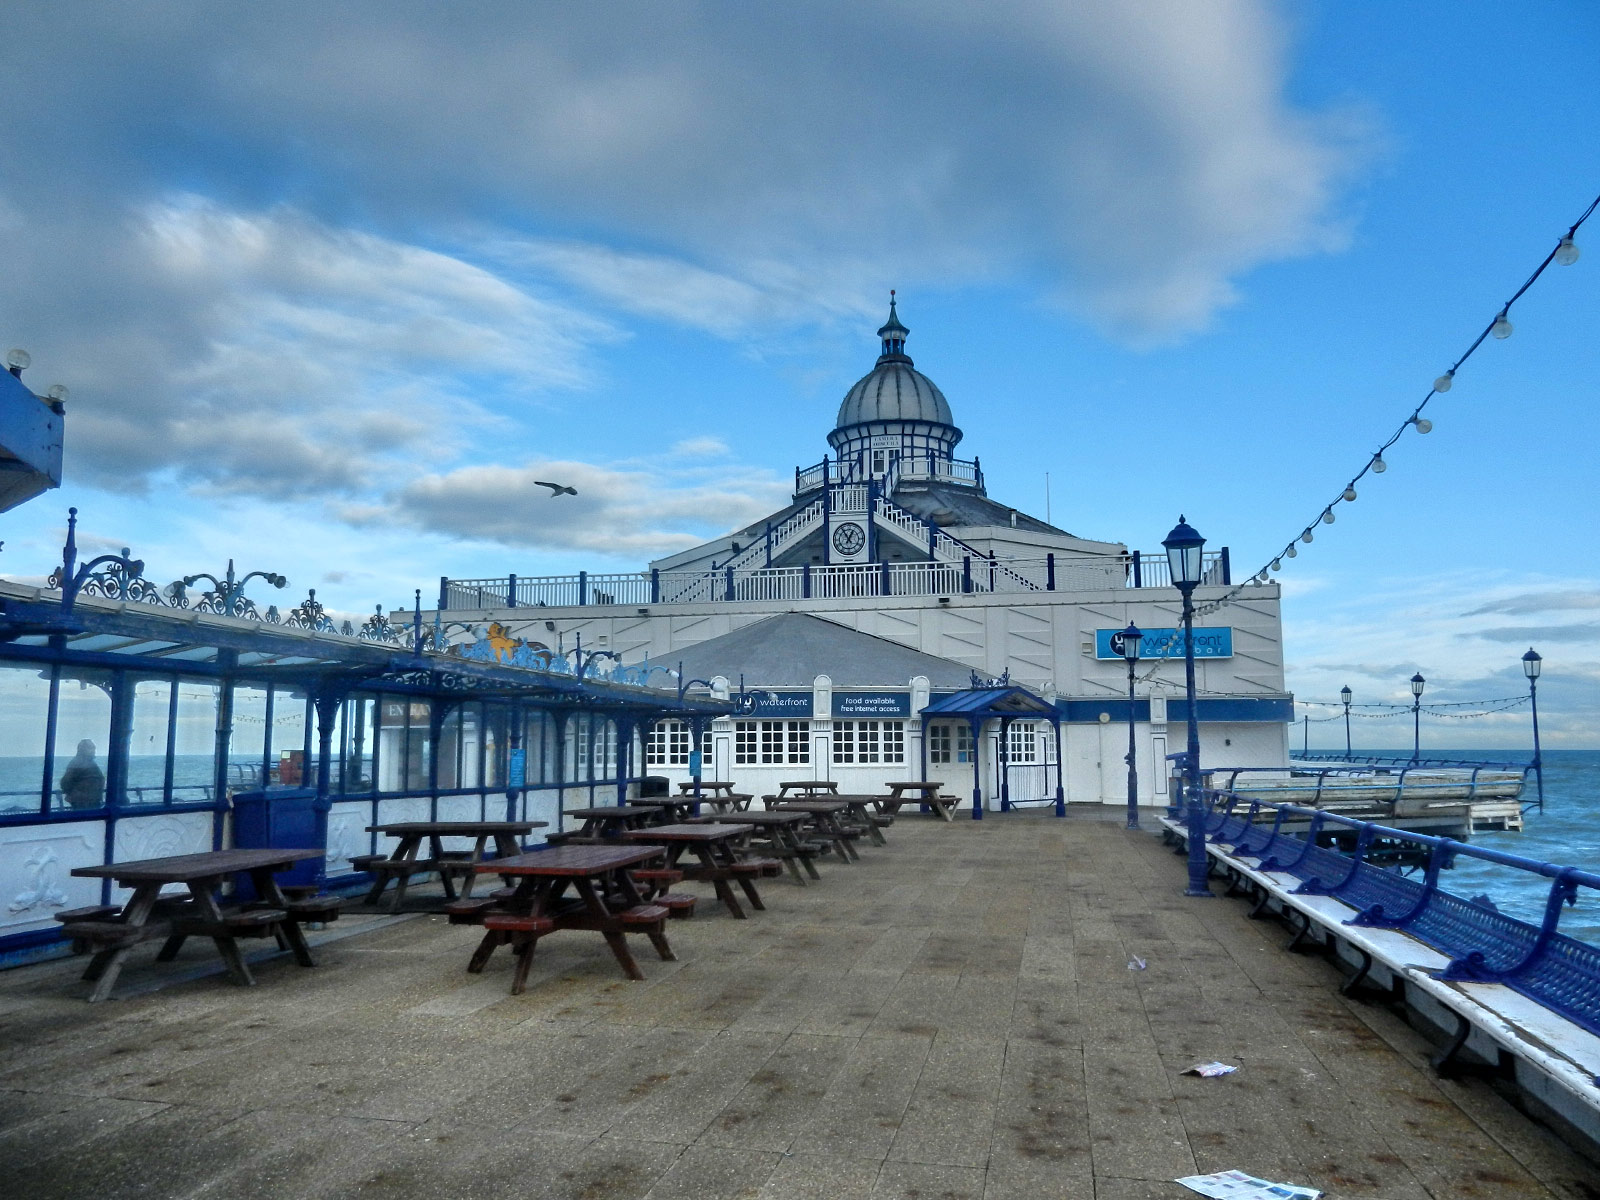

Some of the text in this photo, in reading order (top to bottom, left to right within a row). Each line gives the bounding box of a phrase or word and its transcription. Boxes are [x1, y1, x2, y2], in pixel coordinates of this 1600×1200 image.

[1142, 635, 1222, 646] waeront
[1194, 646, 1222, 654] bar
[759, 697, 808, 706] waterfront
[845, 697, 896, 705] food available
[840, 704, 854, 712] free
